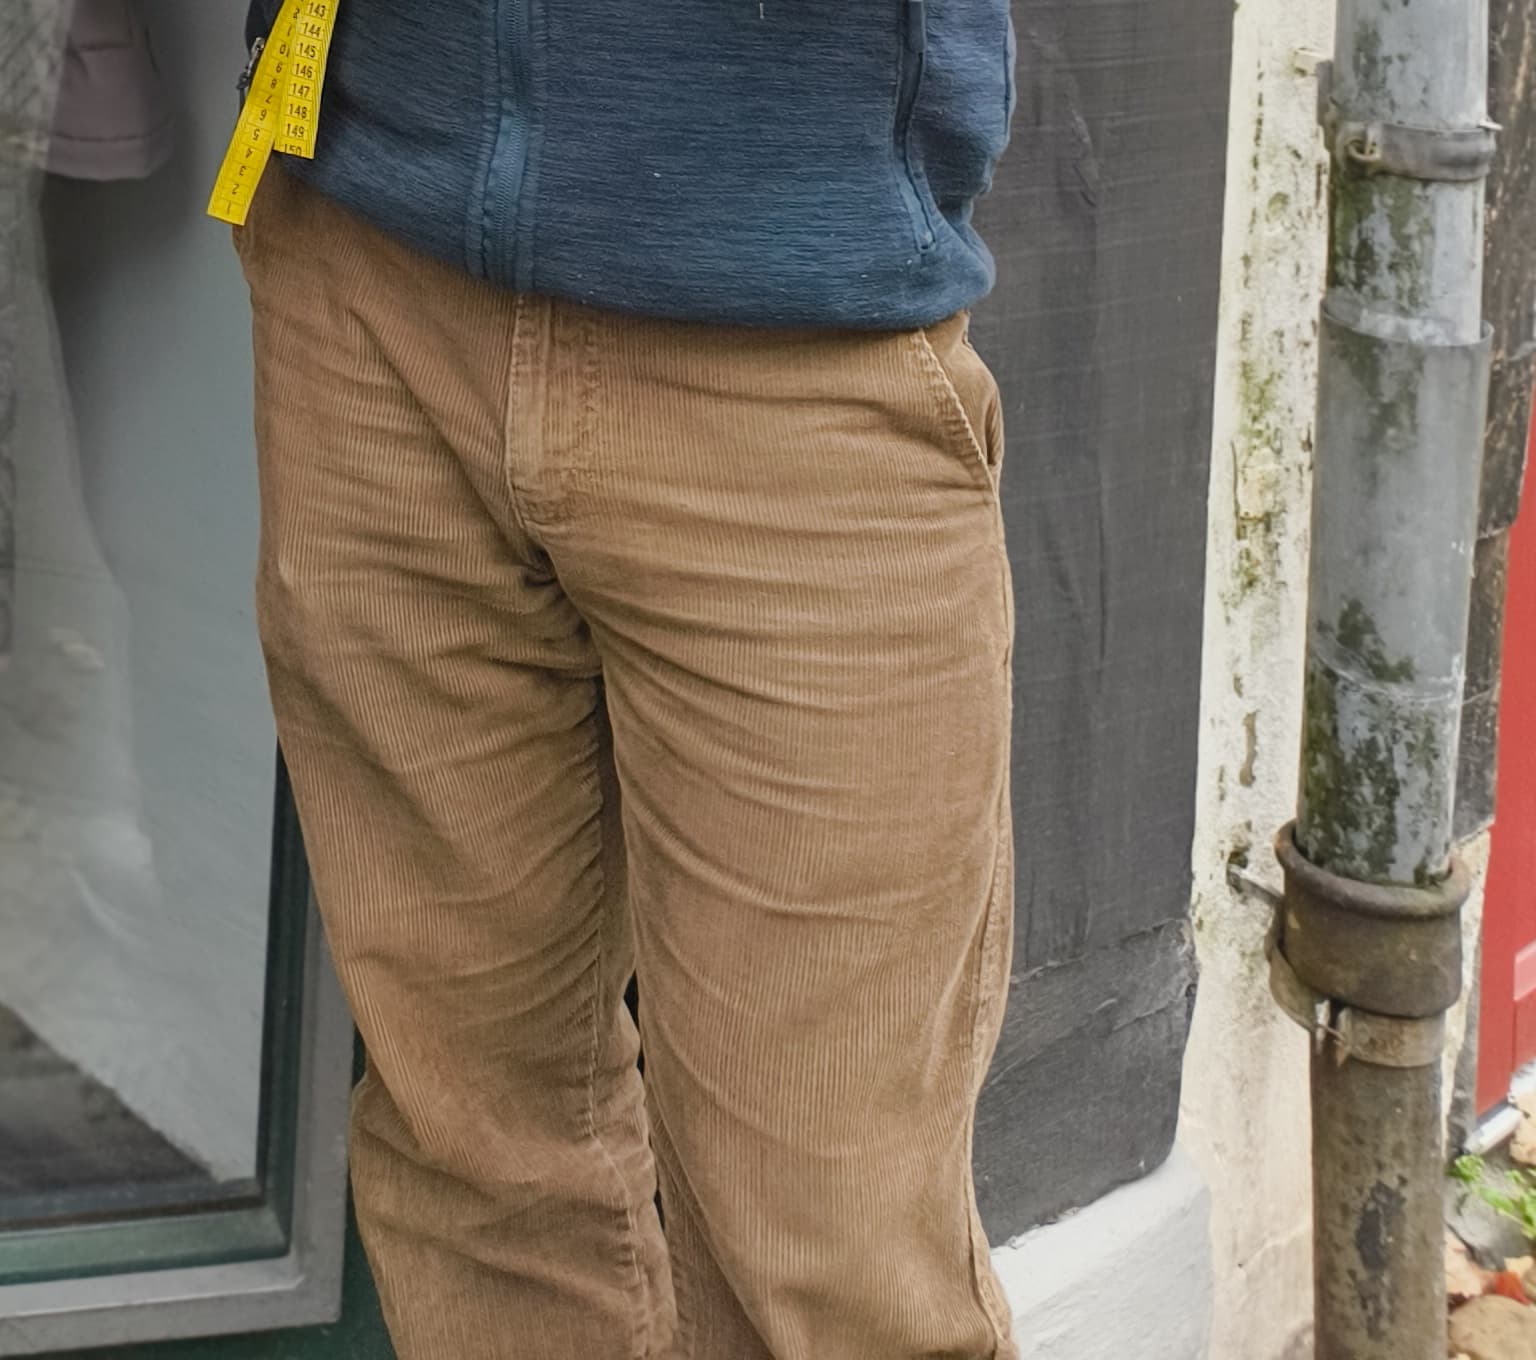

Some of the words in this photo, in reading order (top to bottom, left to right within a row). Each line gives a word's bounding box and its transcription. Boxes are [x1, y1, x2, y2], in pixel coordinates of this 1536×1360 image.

[309, 2, 326, 18] 143
[302, 22, 321, 38] 144
[299, 42, 316, 58] 145
[295, 63, 313, 79] 146
[292, 82, 310, 98] 147
[289, 103, 307, 120] 148
[286, 123, 305, 138] 149
